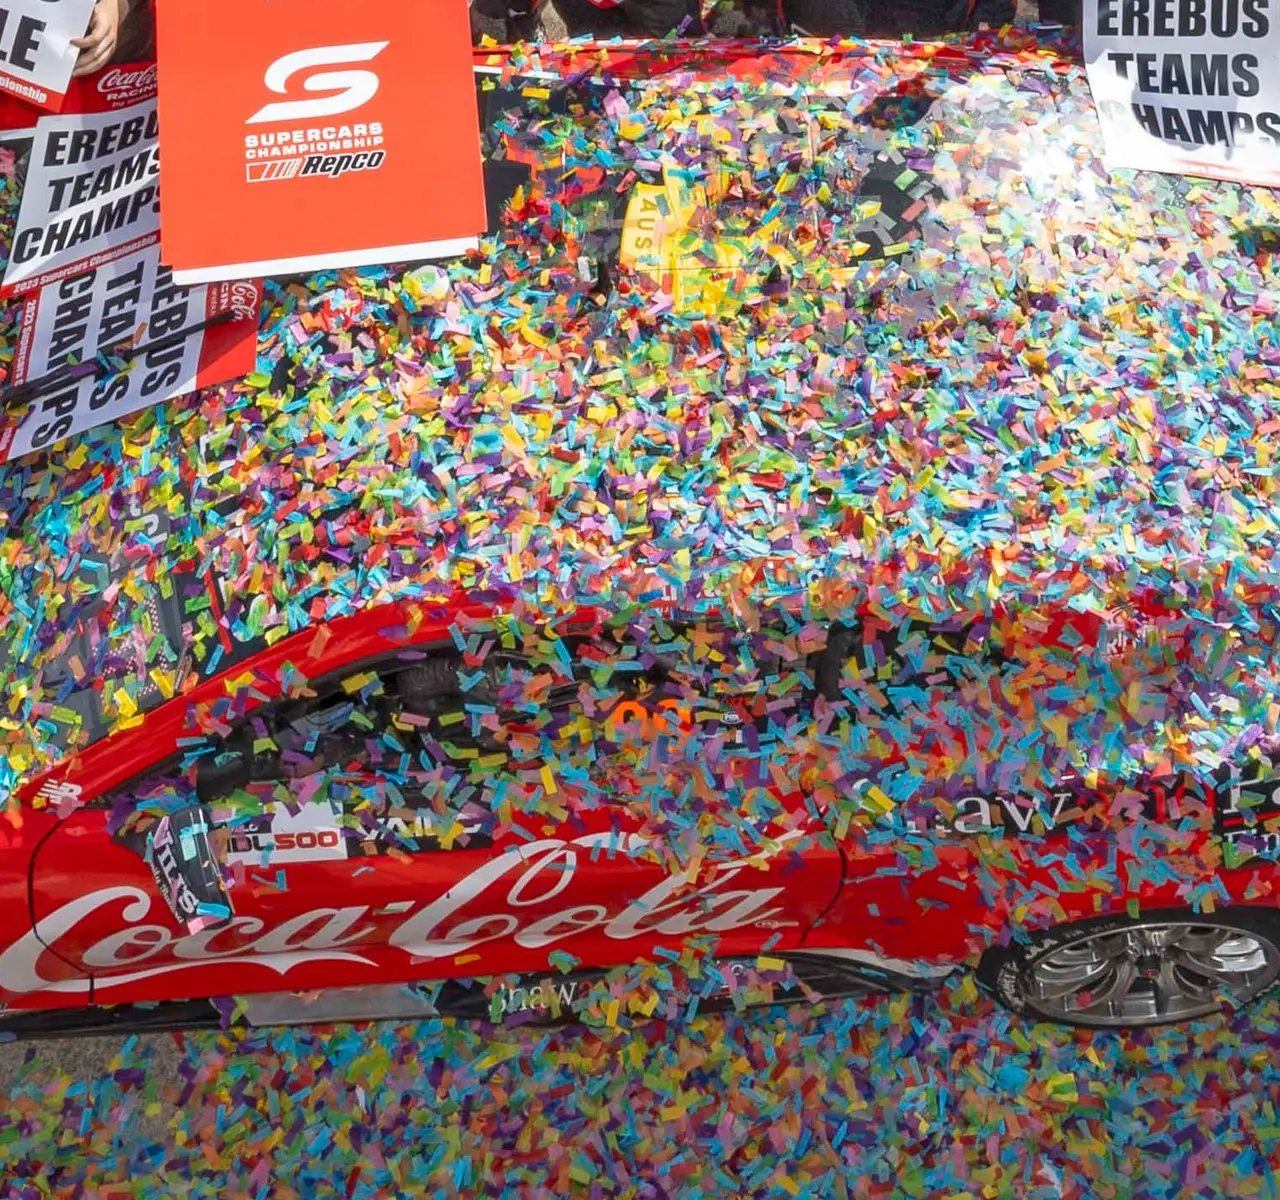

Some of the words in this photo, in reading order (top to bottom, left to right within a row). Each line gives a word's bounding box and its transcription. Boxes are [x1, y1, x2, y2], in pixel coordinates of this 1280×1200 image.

[1108, 53, 1259, 98] TEAMS
[245, 122, 383, 147] SUPERCARS
[245, 136, 384, 159] CHAMPIONSHIP
[299, 150, 386, 178] Repco
